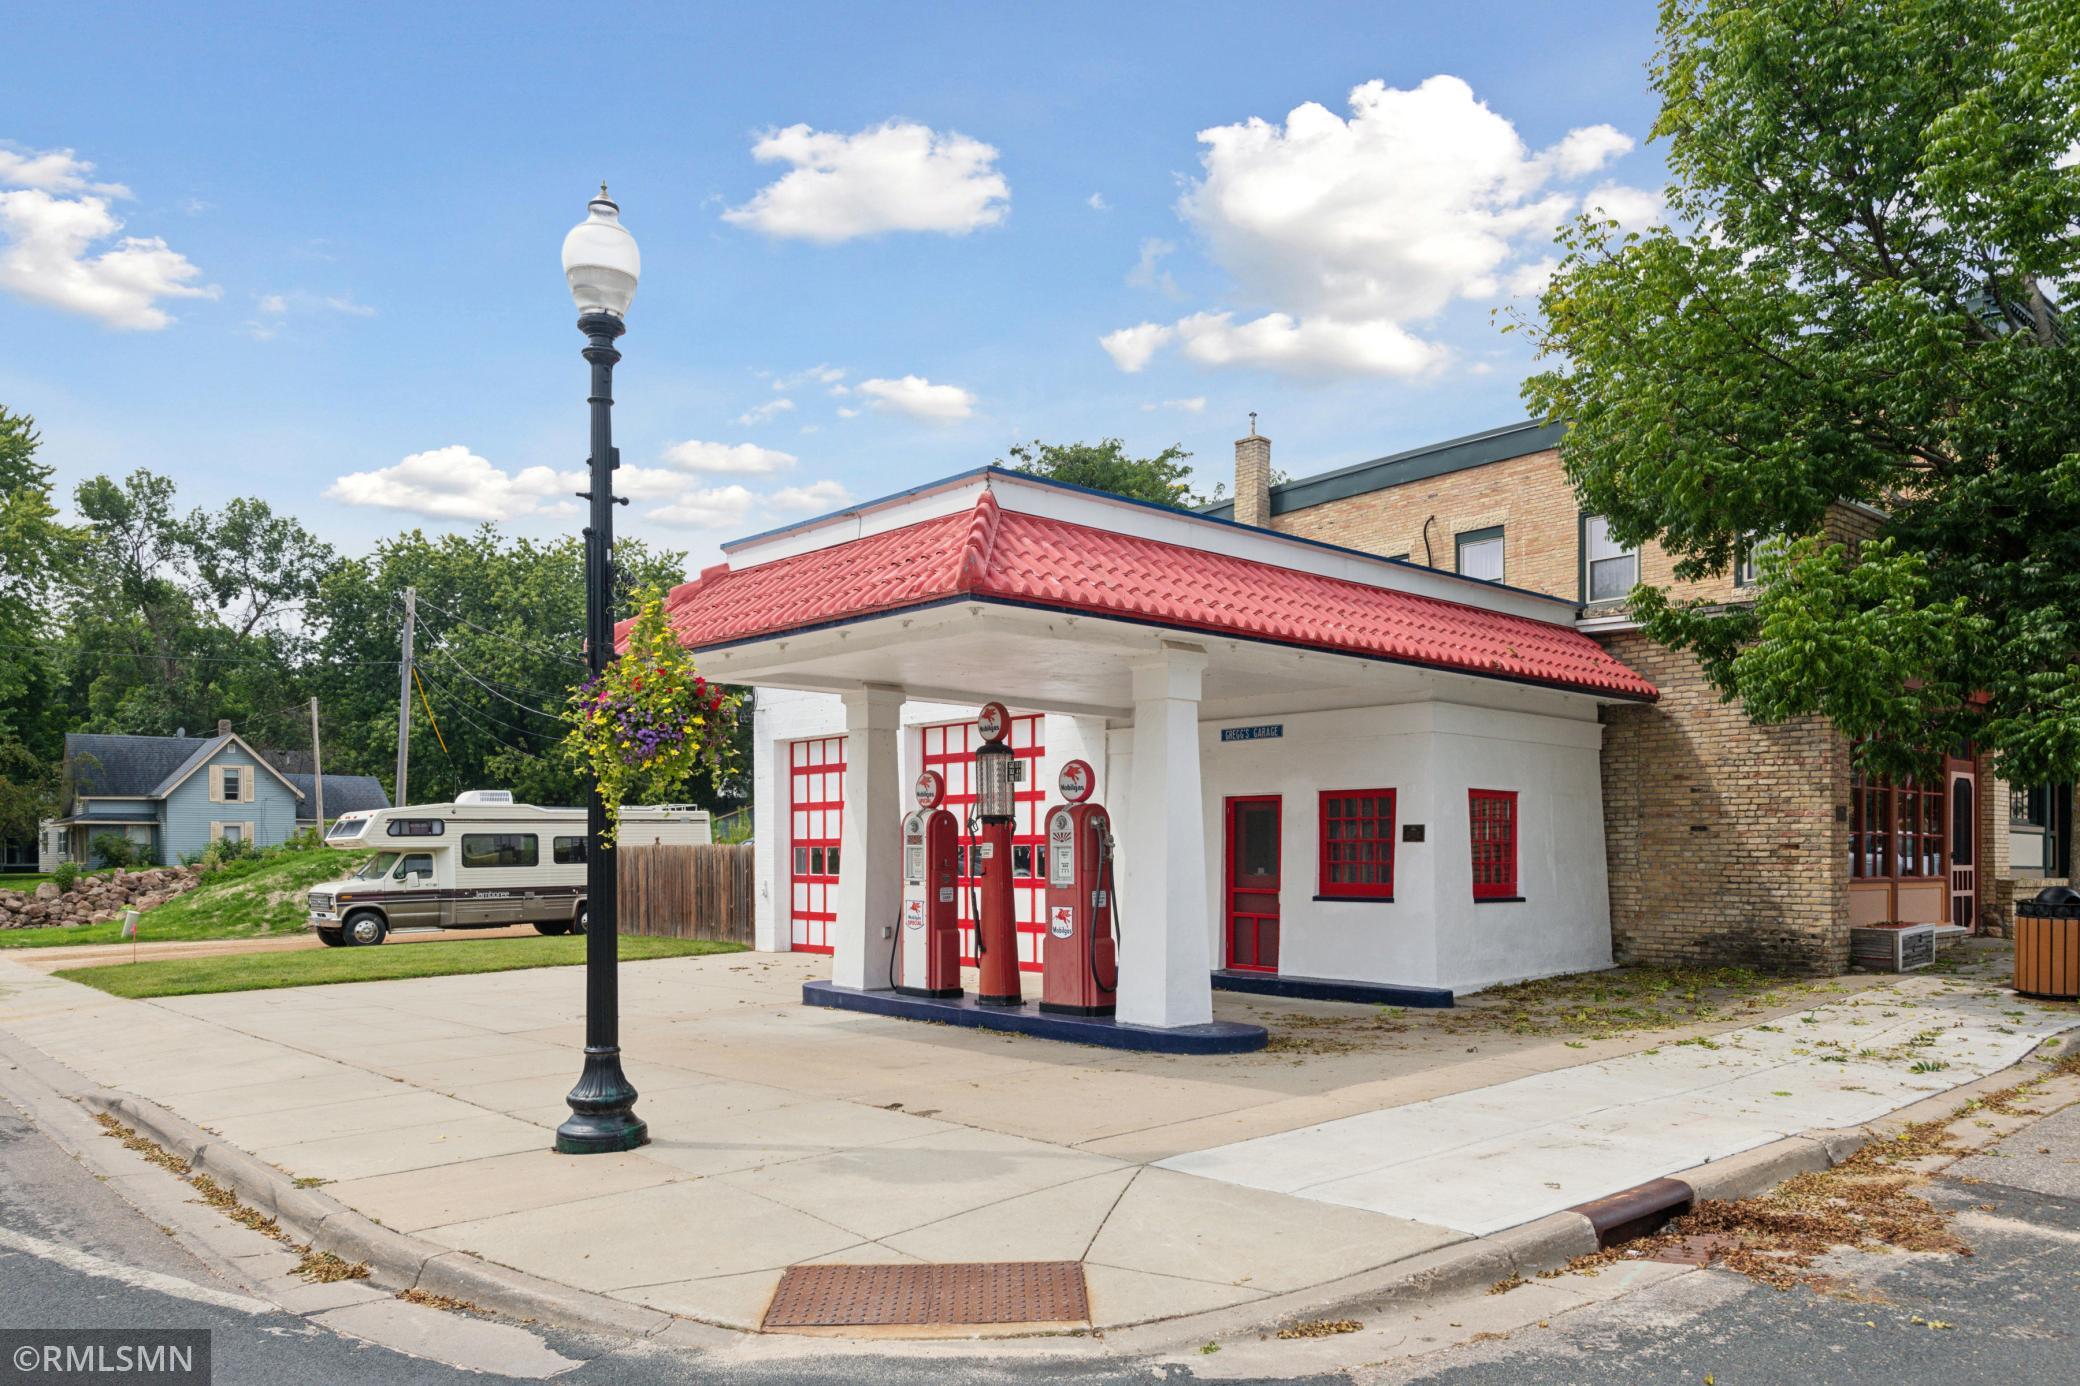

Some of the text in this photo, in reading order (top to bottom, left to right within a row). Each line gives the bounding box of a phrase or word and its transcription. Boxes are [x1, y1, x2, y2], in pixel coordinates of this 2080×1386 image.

[1225, 726, 1279, 740] GREGG'S GARAGE
[1060, 784, 1084, 792] Mobilgas
[1052, 926, 1073, 936] Mobilgas
